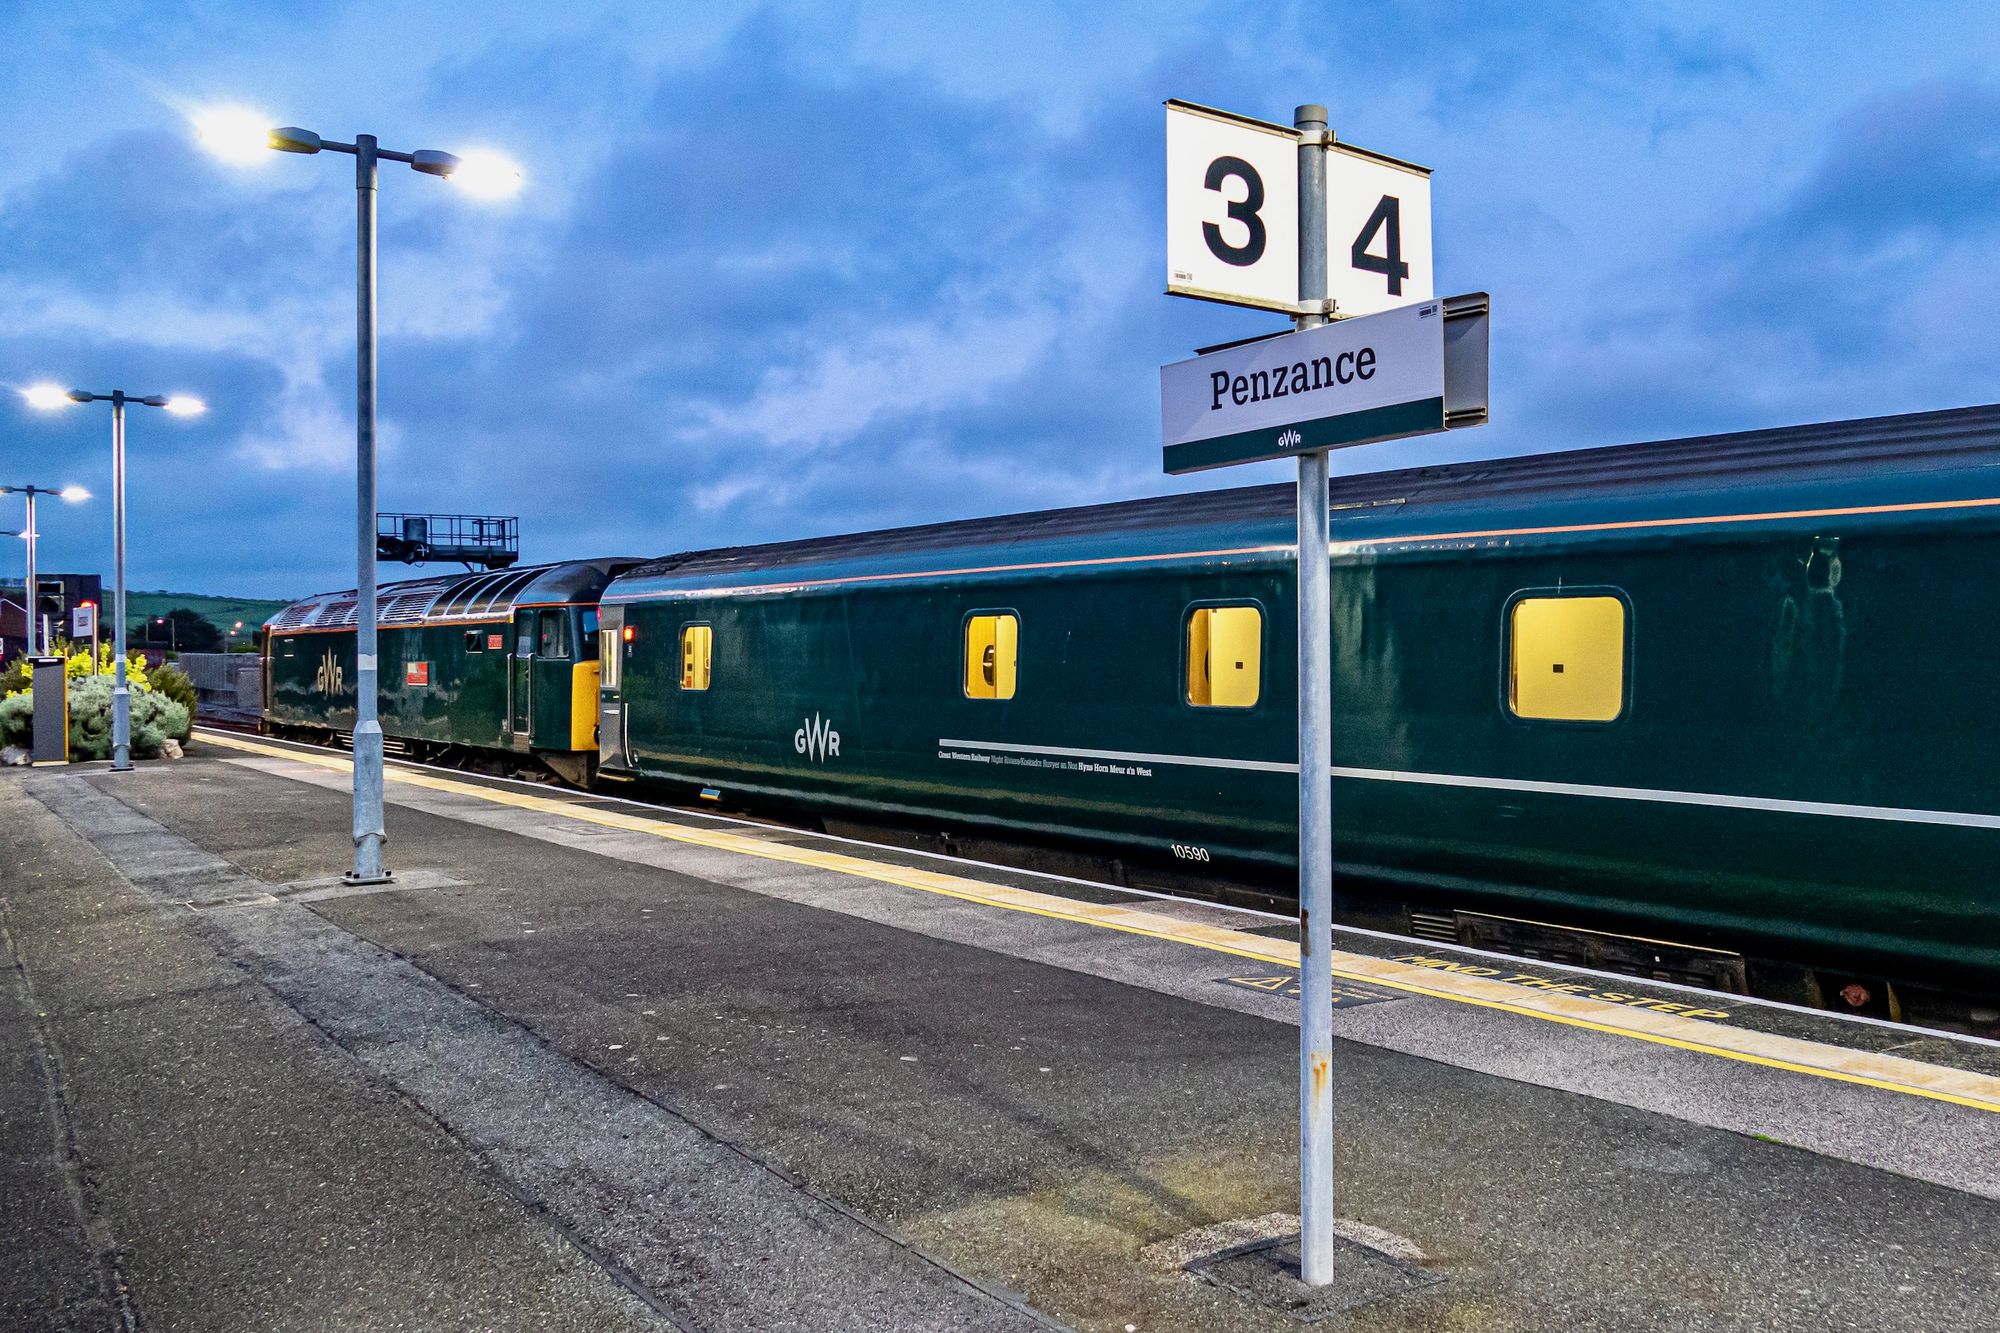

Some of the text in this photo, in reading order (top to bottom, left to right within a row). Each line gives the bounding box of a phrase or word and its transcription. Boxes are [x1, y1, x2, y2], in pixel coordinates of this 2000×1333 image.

[1201, 155, 1267, 267] 3
[1351, 194, 1409, 297] 4
[1210, 347, 1376, 411] Penzance
[1278, 429, 1301, 447] GWR
[317, 647, 343, 696] GWR
[794, 710, 840, 763] GWR
[1136, 767, 1153, 777] West
[1171, 844, 1210, 862] 10590
[1392, 956, 1730, 1018] MIND THE STEP
